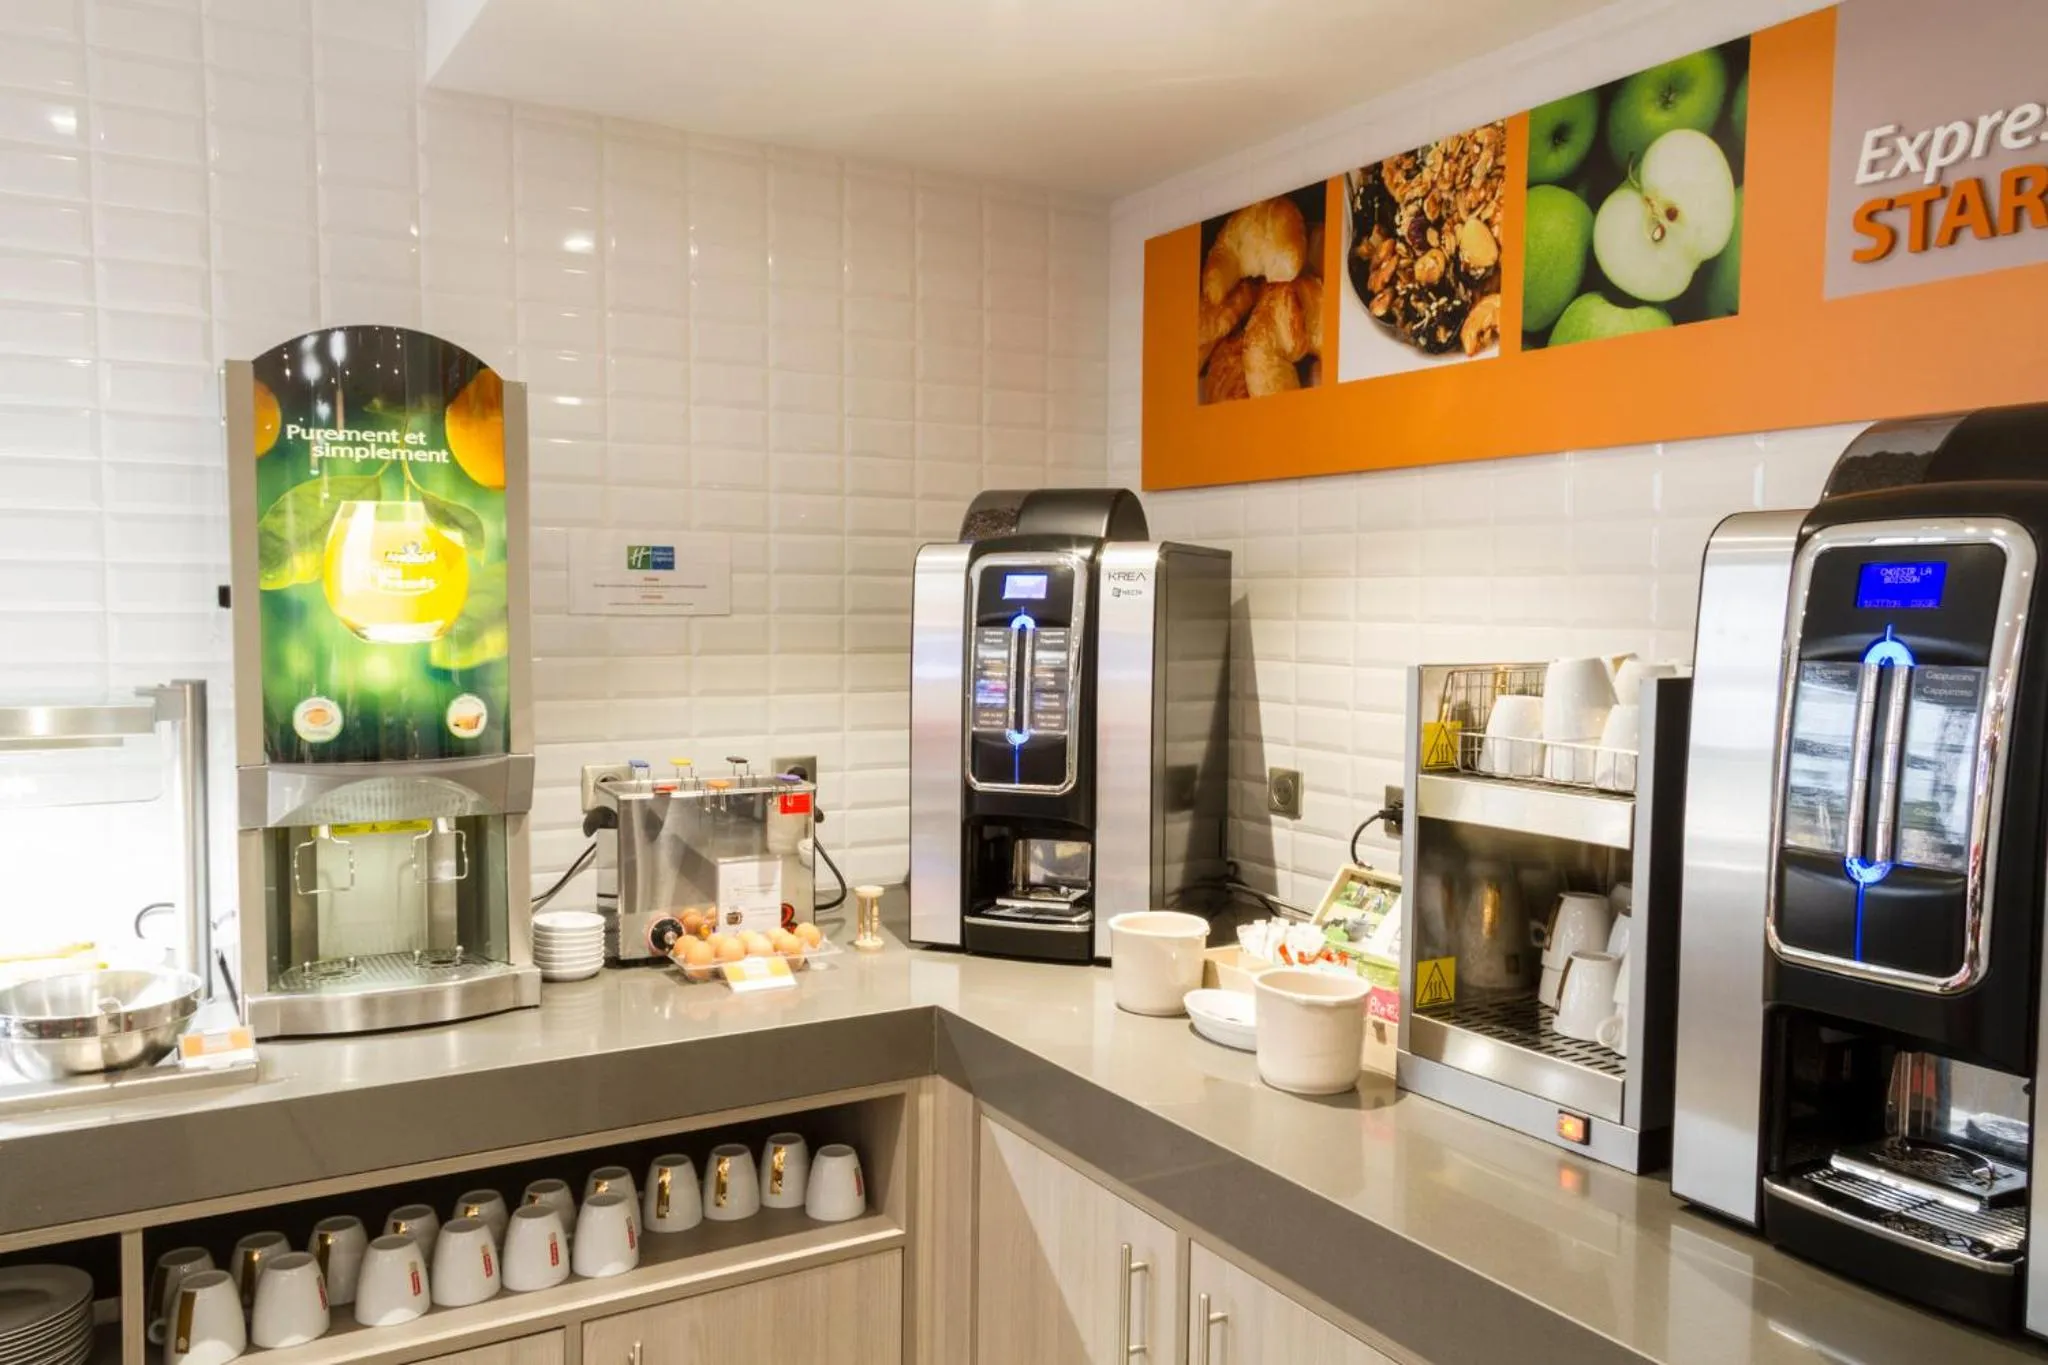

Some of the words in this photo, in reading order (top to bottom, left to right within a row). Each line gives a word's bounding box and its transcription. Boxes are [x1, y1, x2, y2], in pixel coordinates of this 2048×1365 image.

[1855, 102, 2048, 185] Expre
[286, 424, 401, 444] Purement
[404, 431, 427, 445] et
[312, 443, 449, 463] simplement
[1108, 571, 1147, 581] KREA
